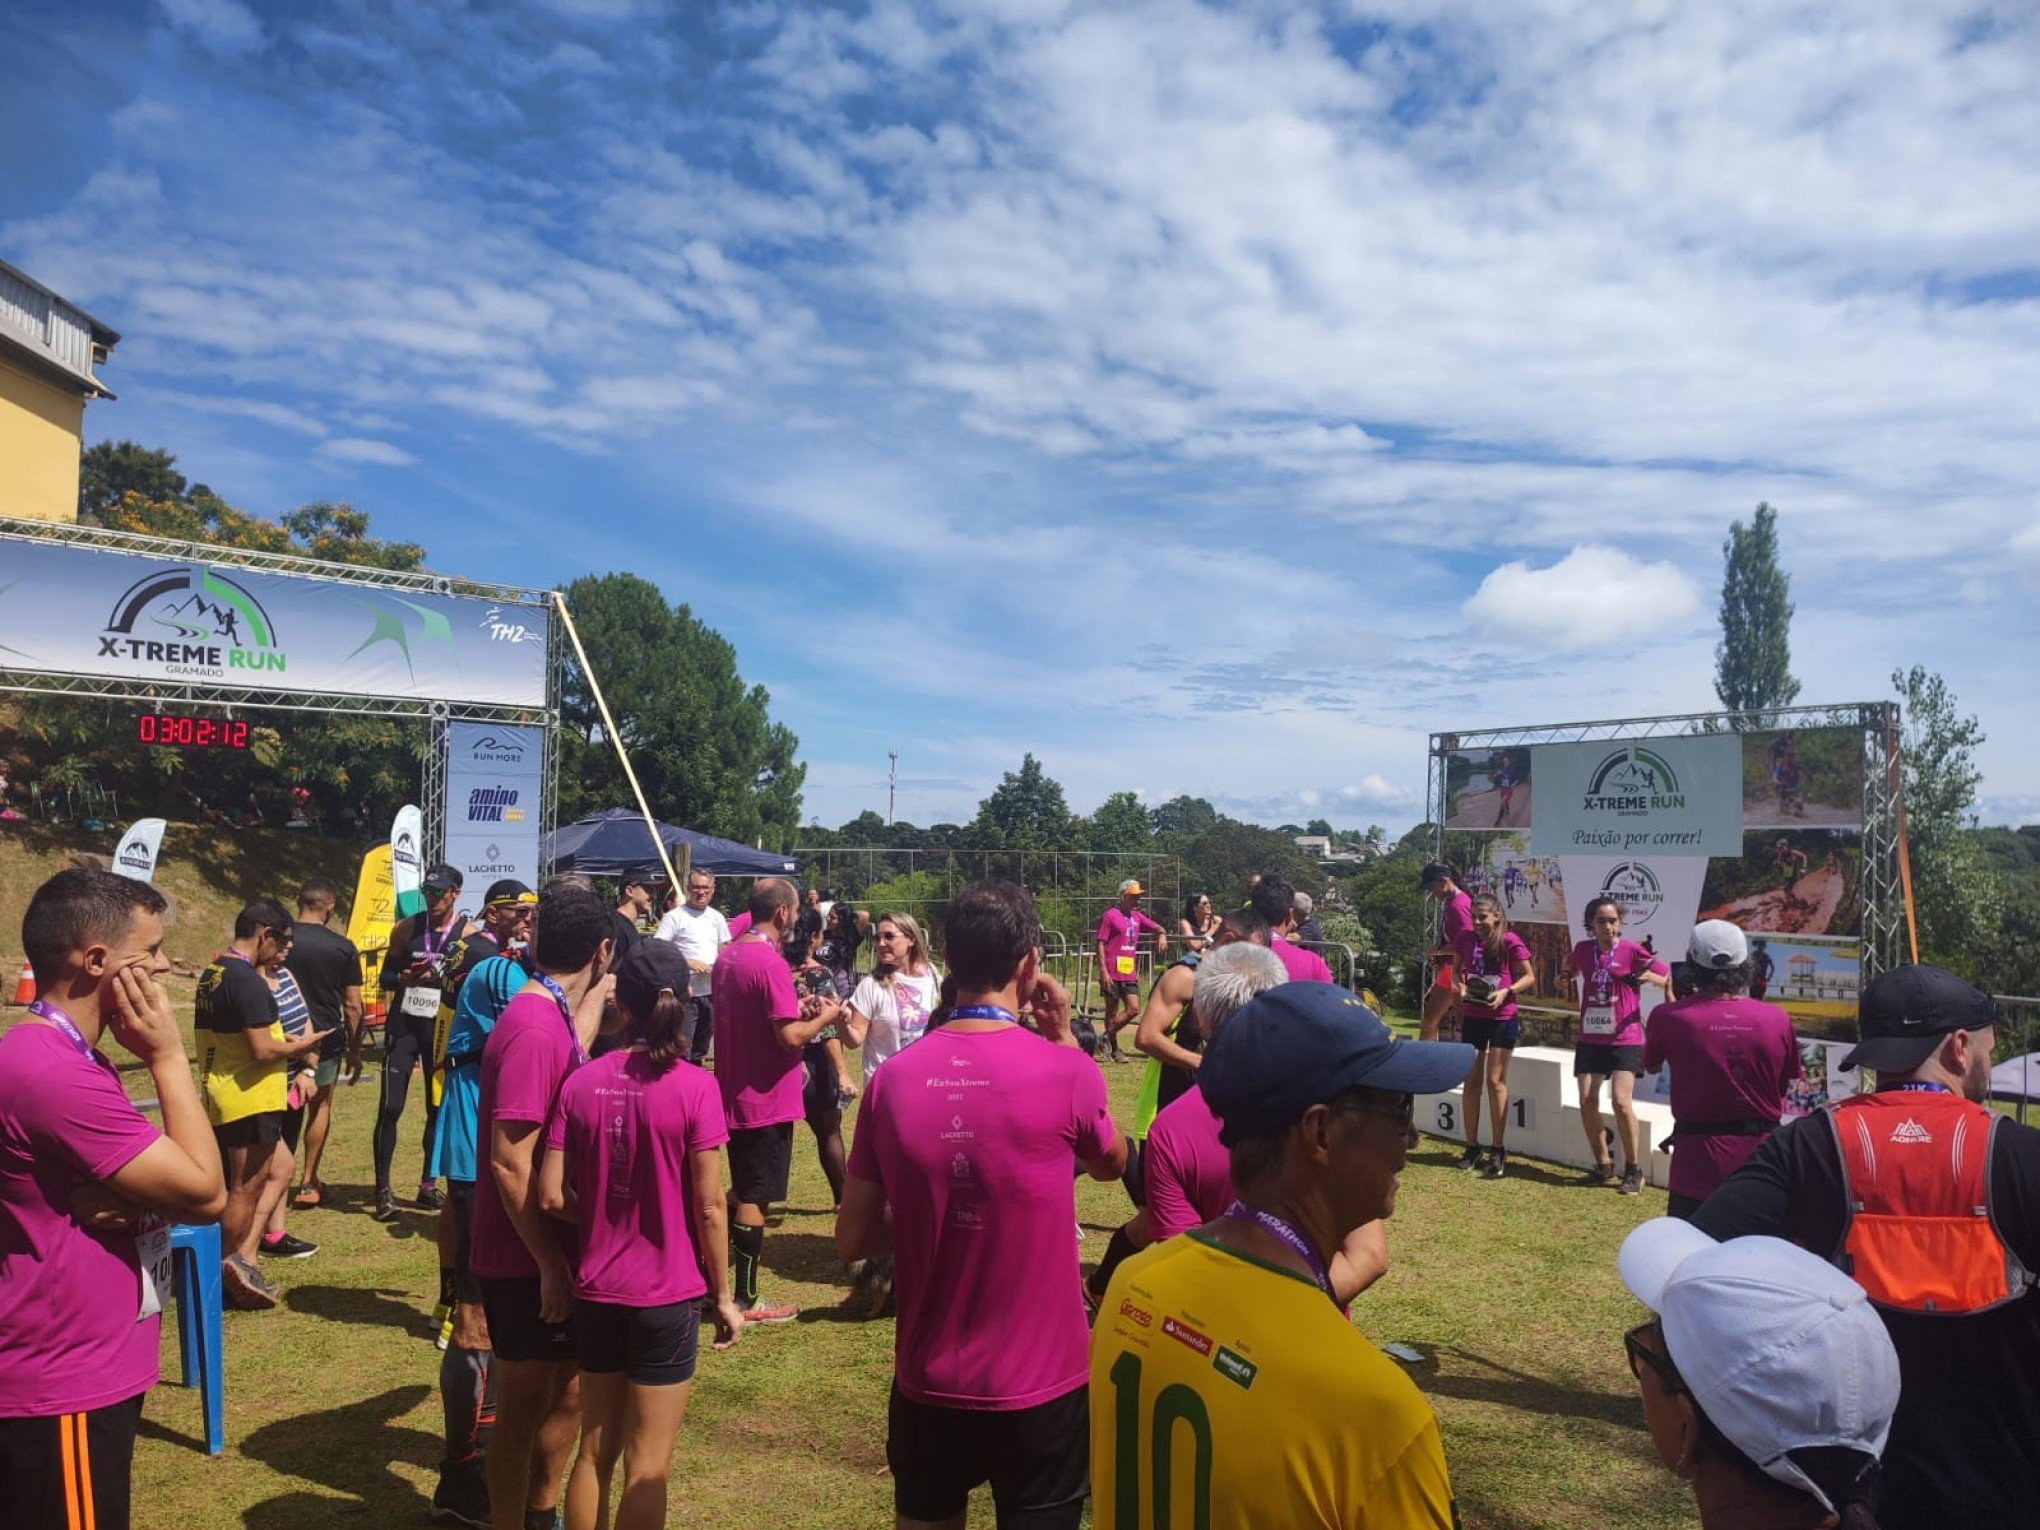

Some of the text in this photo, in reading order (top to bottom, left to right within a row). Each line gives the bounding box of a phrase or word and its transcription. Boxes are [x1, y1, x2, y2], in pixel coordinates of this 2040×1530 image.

[491, 624, 525, 644] TH2
[98, 636, 286, 671] X-TREME RUN
[165, 665, 224, 677] GRAMADO
[140, 716, 247, 747] 03:02:12
[473, 752, 521, 763] RUN MORE
[469, 785, 518, 806] amino
[1583, 795, 1685, 810] X-TREME RUN
[468, 805, 502, 821] VITAL
[1571, 829, 1702, 849] Paixão por correr!
[1642, 893, 1663, 902] RUN
[1437, 1102, 1454, 1131] 3
[1513, 1099, 1526, 1128] 1
[1110, 1350, 1213, 1530] 10
